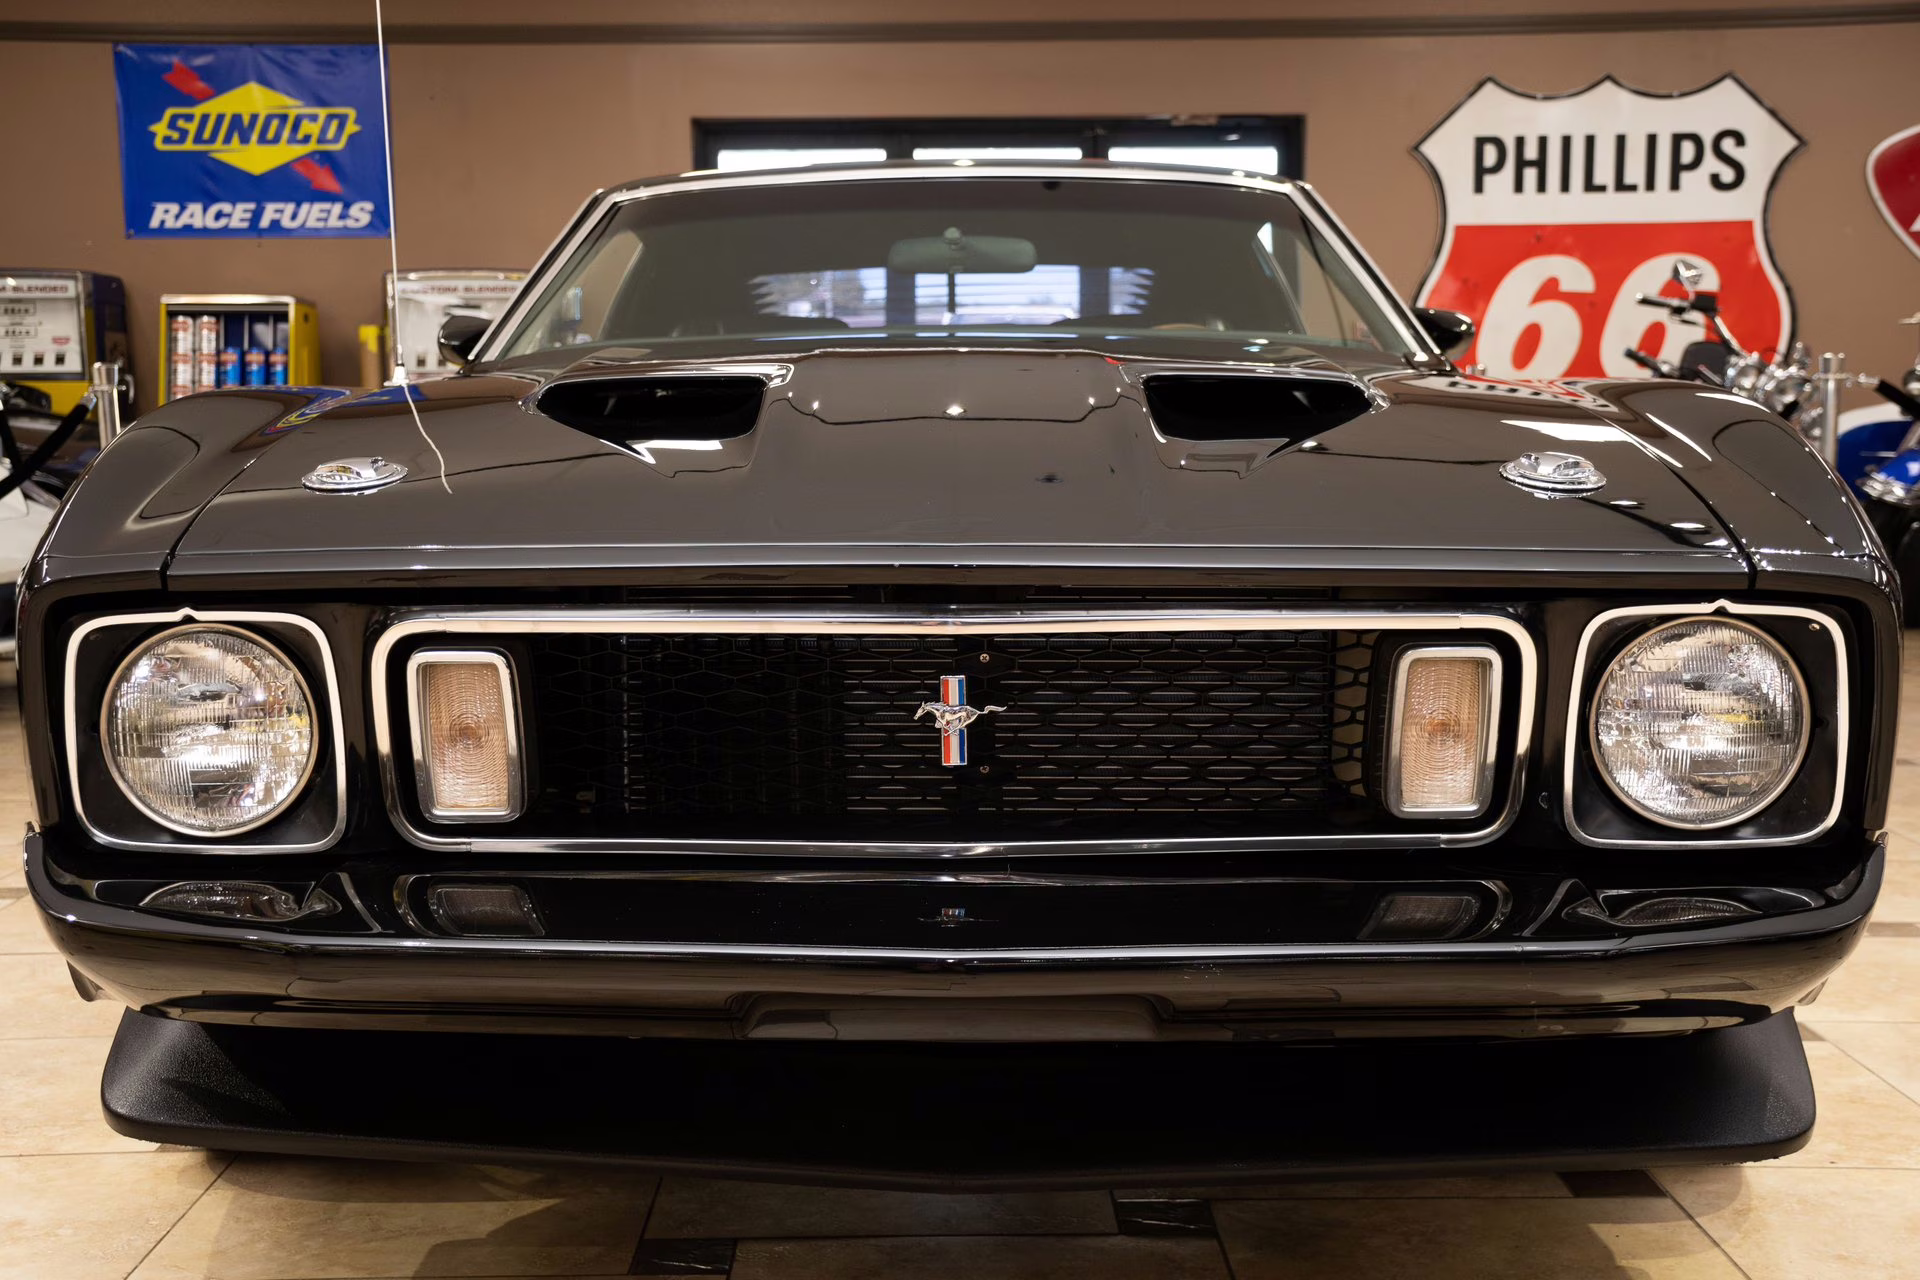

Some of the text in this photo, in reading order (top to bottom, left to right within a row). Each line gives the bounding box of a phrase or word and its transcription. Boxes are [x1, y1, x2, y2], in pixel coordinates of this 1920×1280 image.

[161, 112, 351, 146] SUNOCO
[1473, 129, 1747, 194] PHILLIPS
[149, 201, 375, 229] RACE FUELS
[1475, 253, 1721, 379] 66
